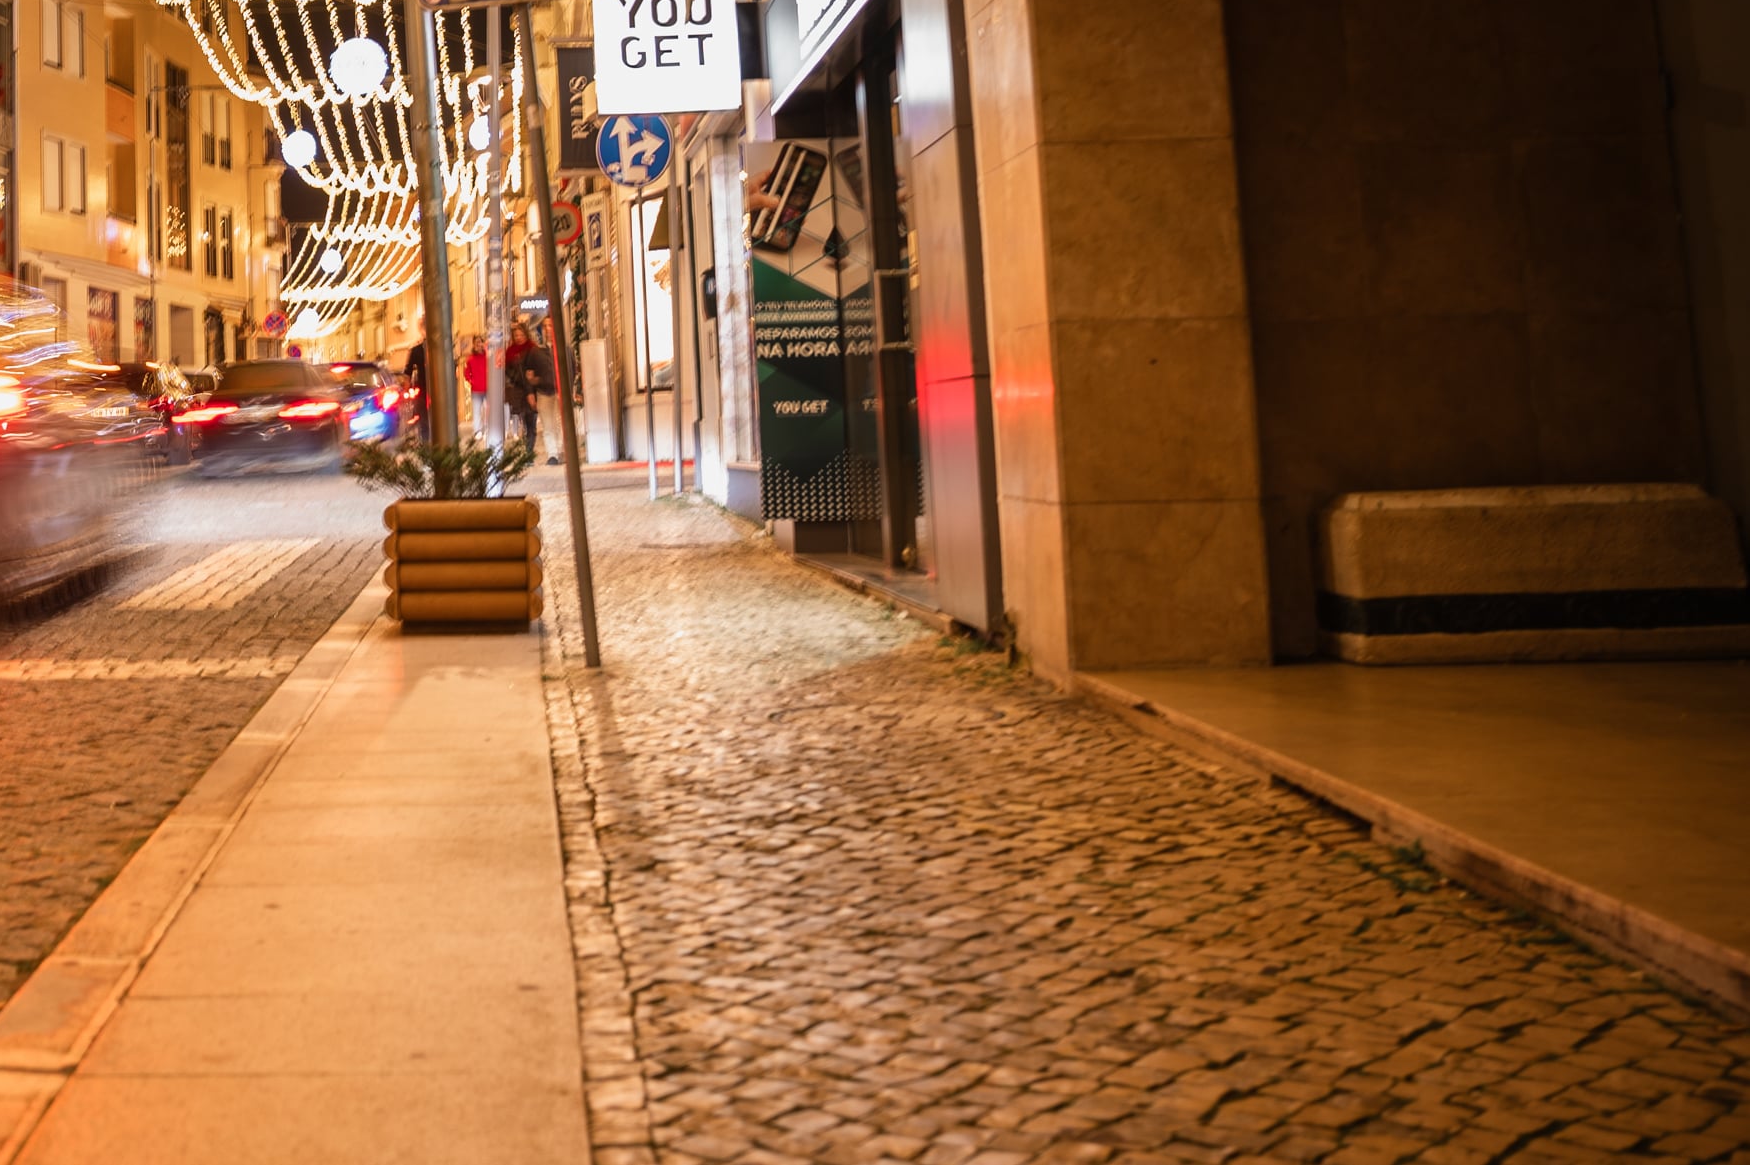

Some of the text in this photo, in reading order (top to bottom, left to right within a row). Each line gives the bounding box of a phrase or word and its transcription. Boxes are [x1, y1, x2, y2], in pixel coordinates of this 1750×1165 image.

[620, 33, 713, 68] GET
[552, 213, 570, 233] 20
[756, 326, 840, 340] REPARAMOS
[757, 343, 784, 358] NA
[787, 341, 840, 357] HORA
[773, 399, 829, 414] YOU GET
